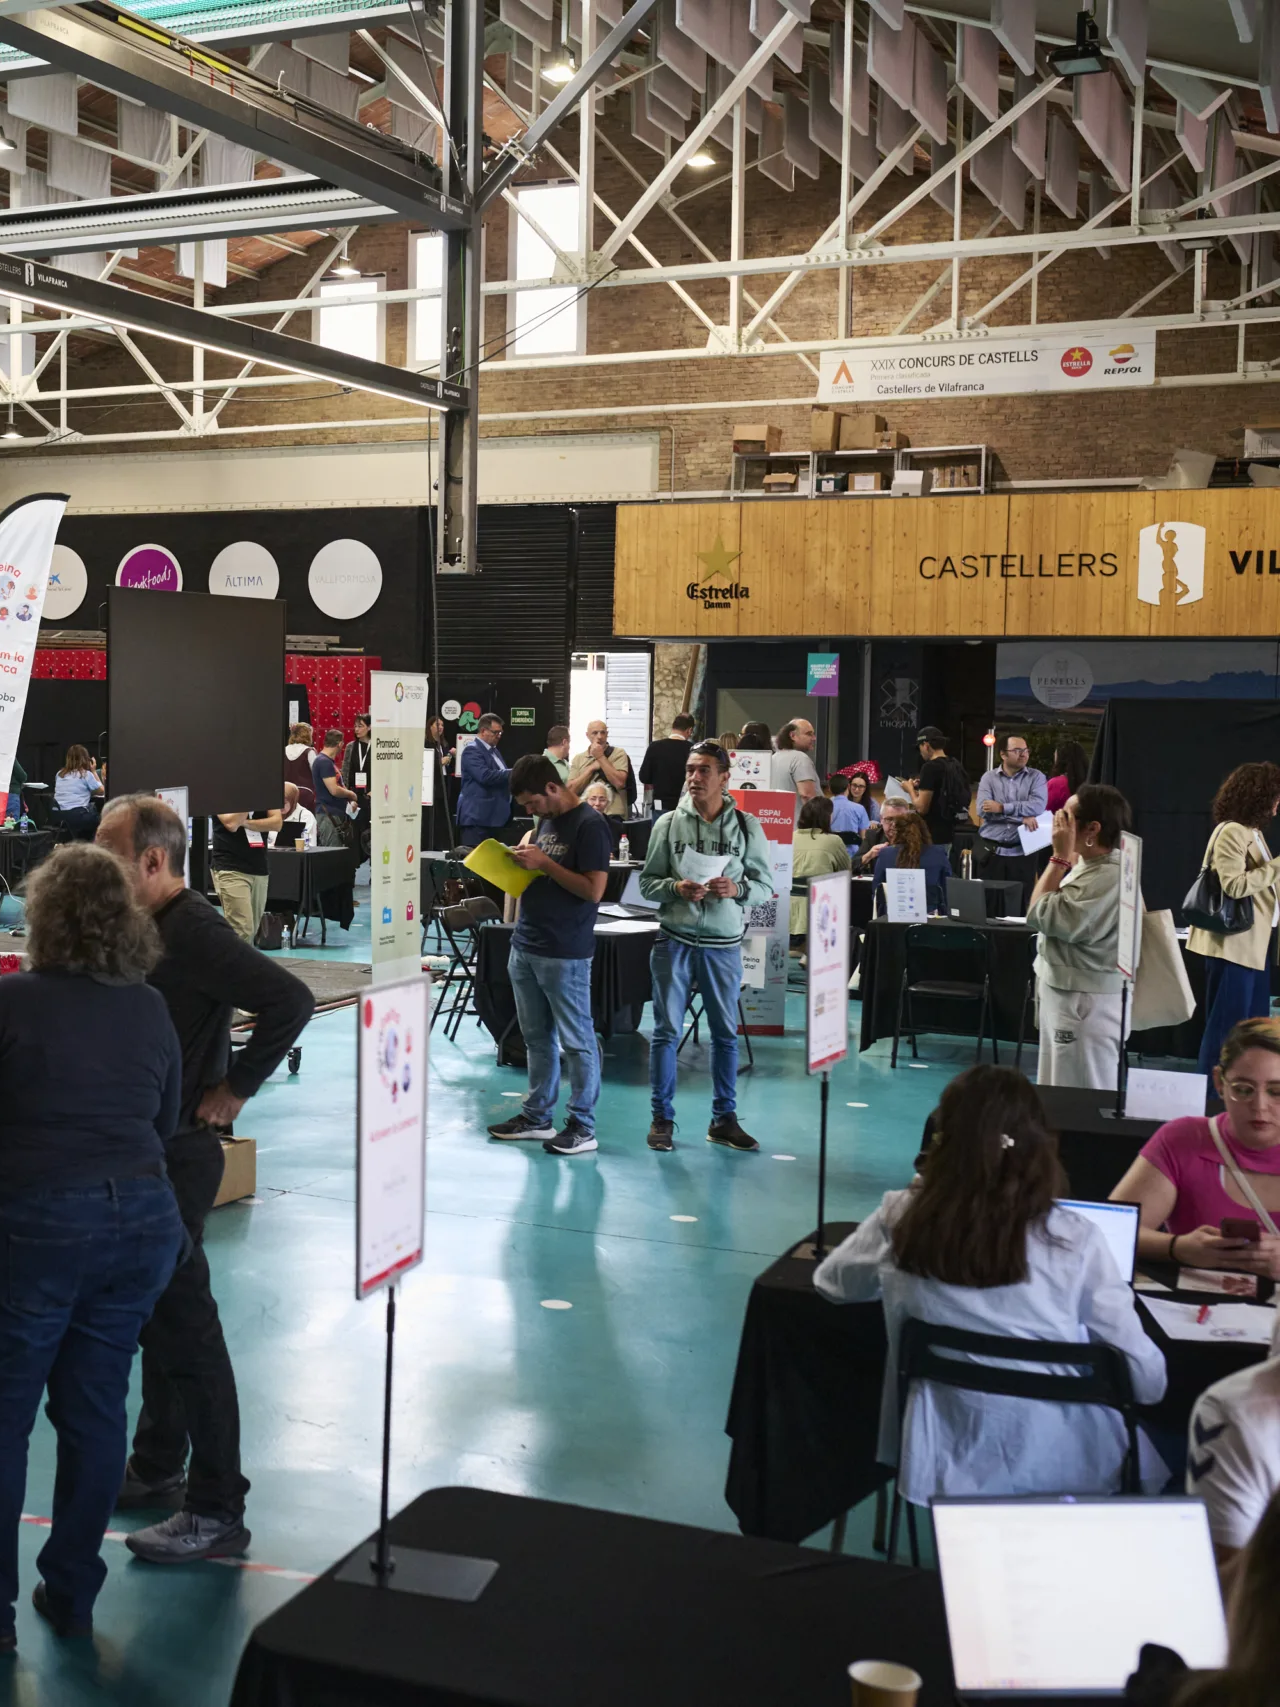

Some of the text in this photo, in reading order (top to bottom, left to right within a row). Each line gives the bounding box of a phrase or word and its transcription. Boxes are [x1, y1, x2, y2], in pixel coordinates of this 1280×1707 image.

[37, 273, 68, 289] VILAFRANCA
[870, 350, 1039, 372] XXIX CONCURS DE CASTELLS
[1062, 360, 1091, 368] ESTRELLA
[1104, 366, 1142, 375] REPSOL
[877, 381, 985, 395] Castellers de Vilafranca
[919, 550, 1280, 579] CASTELLERS VIL
[686, 582, 750, 600] Estrella
[704, 600, 731, 609] Damm
[14, 652, 24, 663] la
[758, 817, 792, 825] ENTACIÓ
